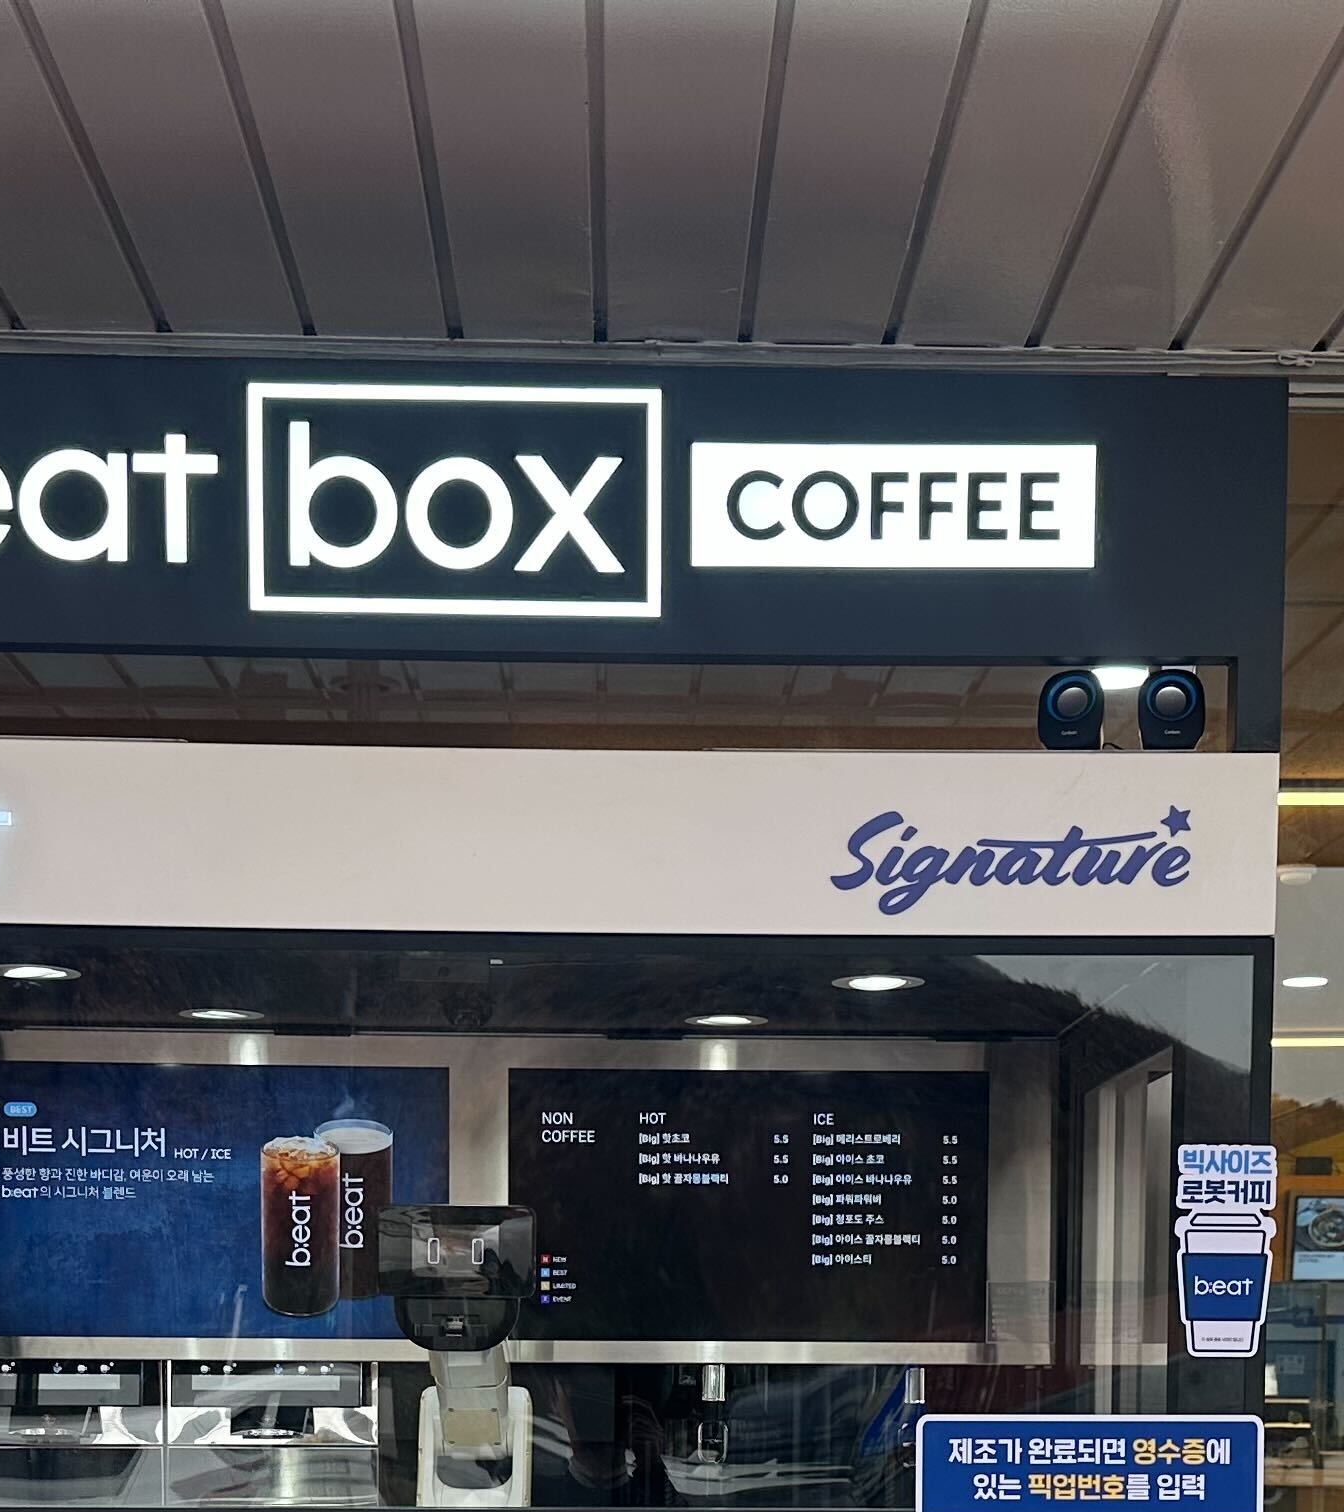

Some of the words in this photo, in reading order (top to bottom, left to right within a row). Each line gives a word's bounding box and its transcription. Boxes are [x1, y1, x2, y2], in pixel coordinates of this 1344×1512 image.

[289, 420, 625, 575] box
[725, 469, 1061, 543] COFFEE
[830, 812, 1192, 916] Signature
[9, 1105, 33, 1114] BEST
[542, 1112, 574, 1125] NON
[639, 1112, 667, 1125] HOT
[813, 1113, 835, 1126] ICE
[3, 1125, 57, 1156] 비트
[61, 1126, 167, 1157] 시그니처
[541, 1129, 596, 1143] COFFEE
[773, 1134, 789, 1144] 5.5
[942, 1135, 958, 1145] 5.5
[173, 1148, 199, 1160] HOT
[210, 1148, 232, 1160] ICE
[673, 1153, 720, 1164] 바나나우유
[773, 1154, 789, 1164] 5.5
[835, 1154, 865, 1164] 아이스
[866, 1154, 885, 1164] 초코
[942, 1155, 958, 1165] 5.5
[1183, 1150, 1273, 1175] 빅사이즈
[2, 1167, 36, 1181] 풍성한
[39, 1167, 62, 1181] 향과
[64, 1167, 89, 1181] 진한
[90, 1168, 127, 1182] 바디감,
[129, 1168, 164, 1182] 여운이
[166, 1169, 189, 1183] 오래
[191, 1169, 216, 1184] 남는
[773, 1174, 789, 1184] 5.0
[835, 1174, 864, 1186] 아이스
[865, 1174, 913, 1186] 바나나우유
[942, 1175, 958, 1185] 5.5
[54, 1185, 99, 1199] 시그니처
[102, 1186, 137, 1200] 블렌드
[1181, 1180, 1271, 1204] 로봇커피
[942, 1195, 958, 1205] 5.0
[835, 1214, 864, 1226] 청포도
[865, 1214, 885, 1226] 주스
[942, 1215, 957, 1225] 5.0
[835, 1234, 864, 1244] 아이스
[941, 1235, 957, 1245] 5.0
[834, 1254, 872, 1266] 아이스티
[941, 1255, 957, 1265] 5.0
[948, 1438, 1023, 1466] 제조가
[1027, 1438, 1126, 1466] 완료되면
[1132, 1438, 1231, 1466] 영수증에
[972, 1474, 1022, 1501] 있는
[1027, 1473, 1150, 1501] 픽업번호를
[1156, 1474, 1206, 1501] 입력
